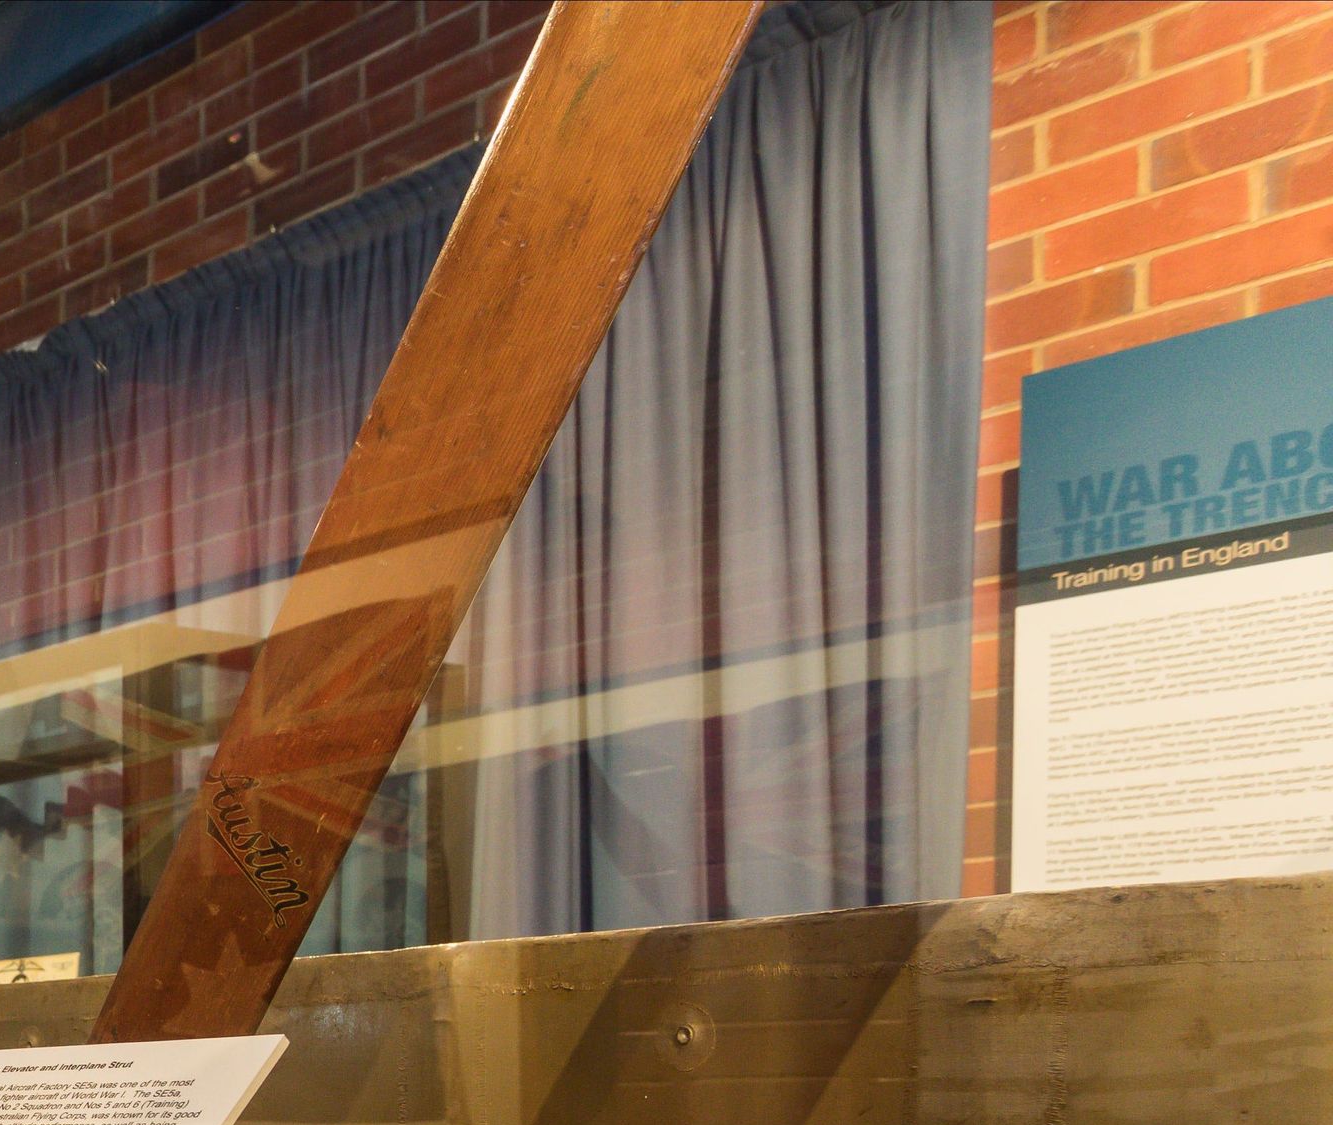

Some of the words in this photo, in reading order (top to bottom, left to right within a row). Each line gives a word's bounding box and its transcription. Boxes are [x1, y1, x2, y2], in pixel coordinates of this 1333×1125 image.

[1057, 453, 1200, 522] WAR
[1219, 422, 1333, 491] AB
[1053, 509, 1148, 558] THE
[1052, 562, 1145, 590] Training
[1151, 555, 1175, 573] in
[1181, 531, 1291, 568] England
[205, 767, 309, 928] Austin
[59, 1063, 106, 1071] Interplane
[38, 1083, 72, 1091] Factory
[72, 1082, 98, 1090] SE5a
[0, 1094, 28, 1102] fighter
[28, 1092, 59, 1100] aircraft
[100, 1091, 120, 1099] War
[133, 1090, 152, 1098] The
[153, 1089, 181, 1098] SE5a,
[20, 1103, 63, 1111] Squadron
[64, 1102, 84, 1110] and
[112, 1101, 133, 1109] and
[141, 1100, 189, 1110] (Training)
[31, 1112, 58, 1121] Flying
[59, 1112, 90, 1122] Corps,
[173, 1110, 202, 1120] good
